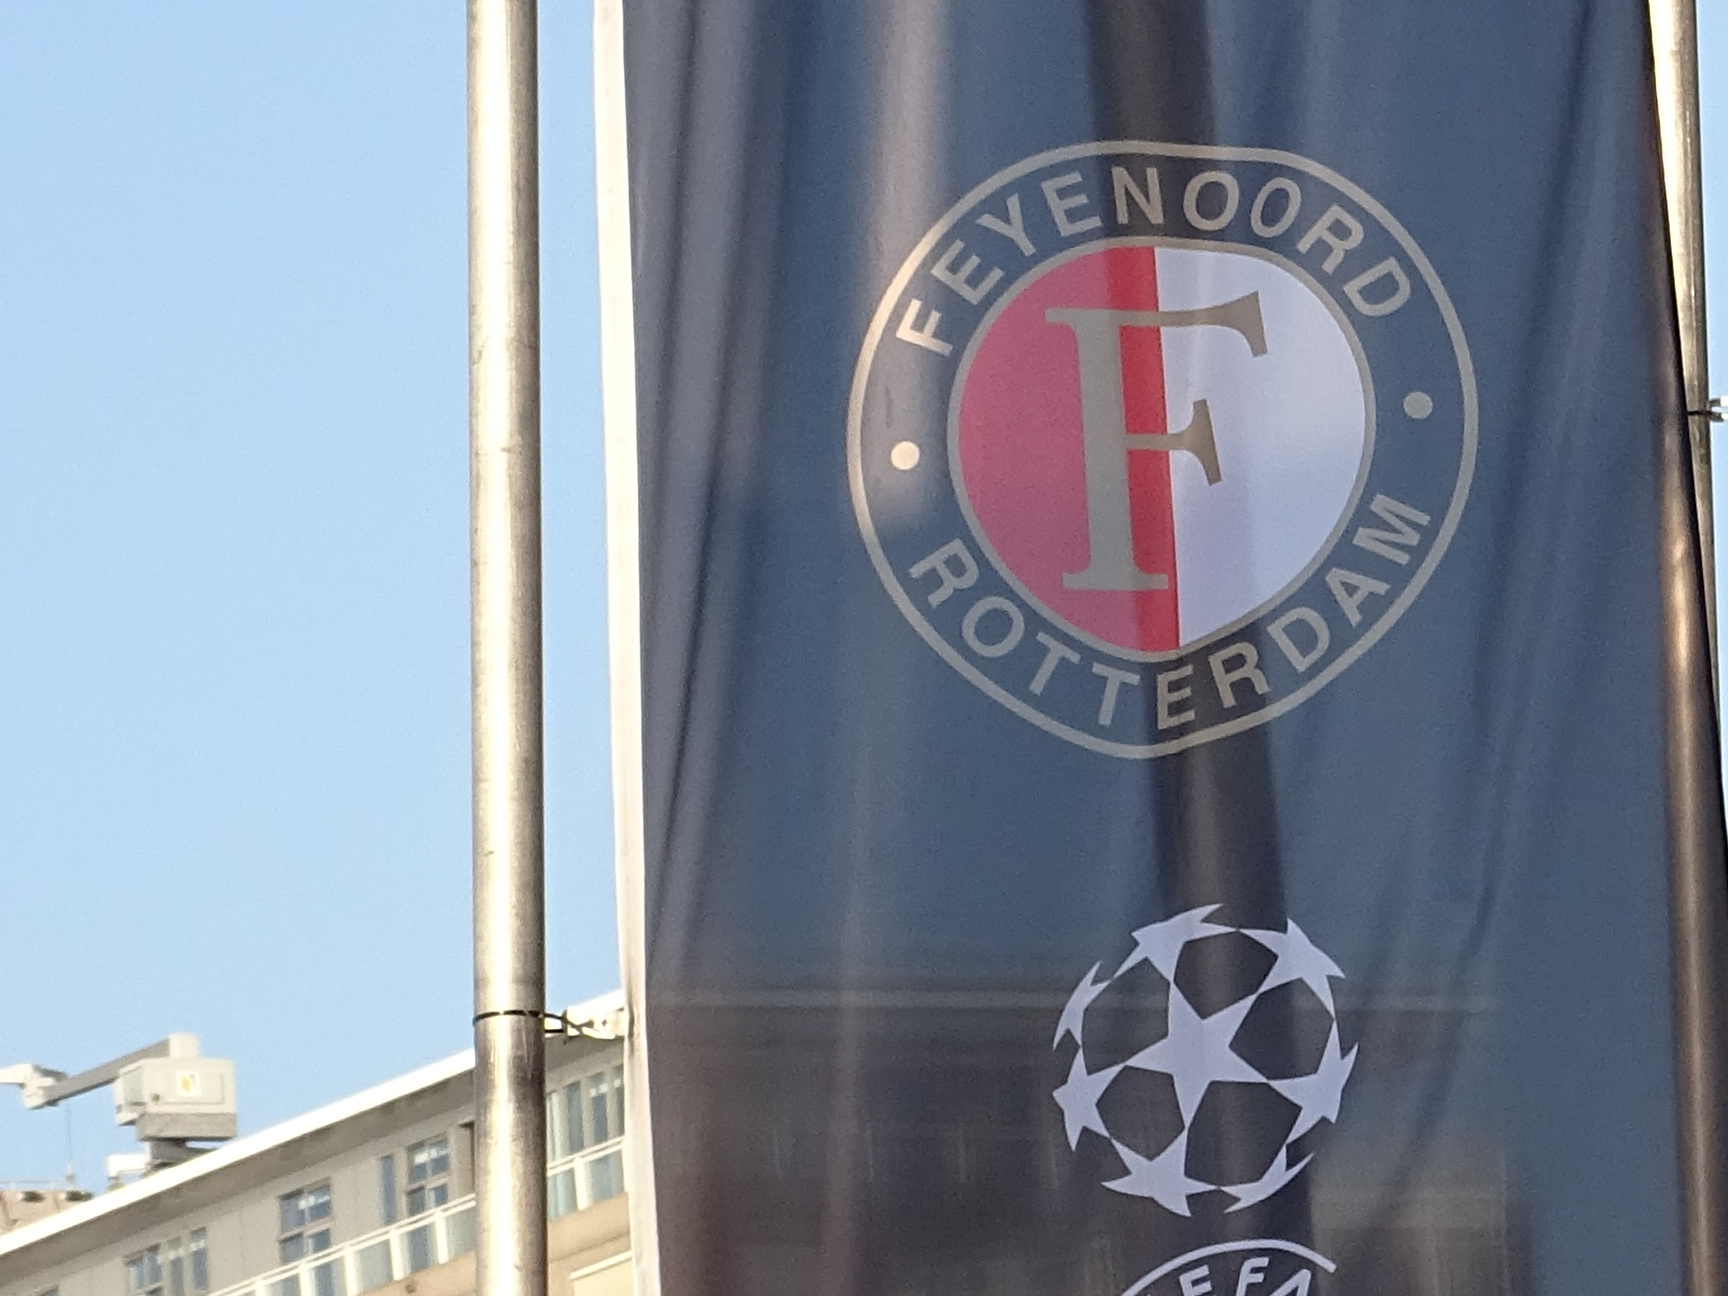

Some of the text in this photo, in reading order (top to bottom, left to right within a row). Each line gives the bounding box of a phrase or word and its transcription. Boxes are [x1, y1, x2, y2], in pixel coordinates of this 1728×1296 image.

[895, 165, 1411, 357] FEYENOORD
[1044, 291, 1268, 591] F
[908, 493, 1431, 730] ROTTERDAM
